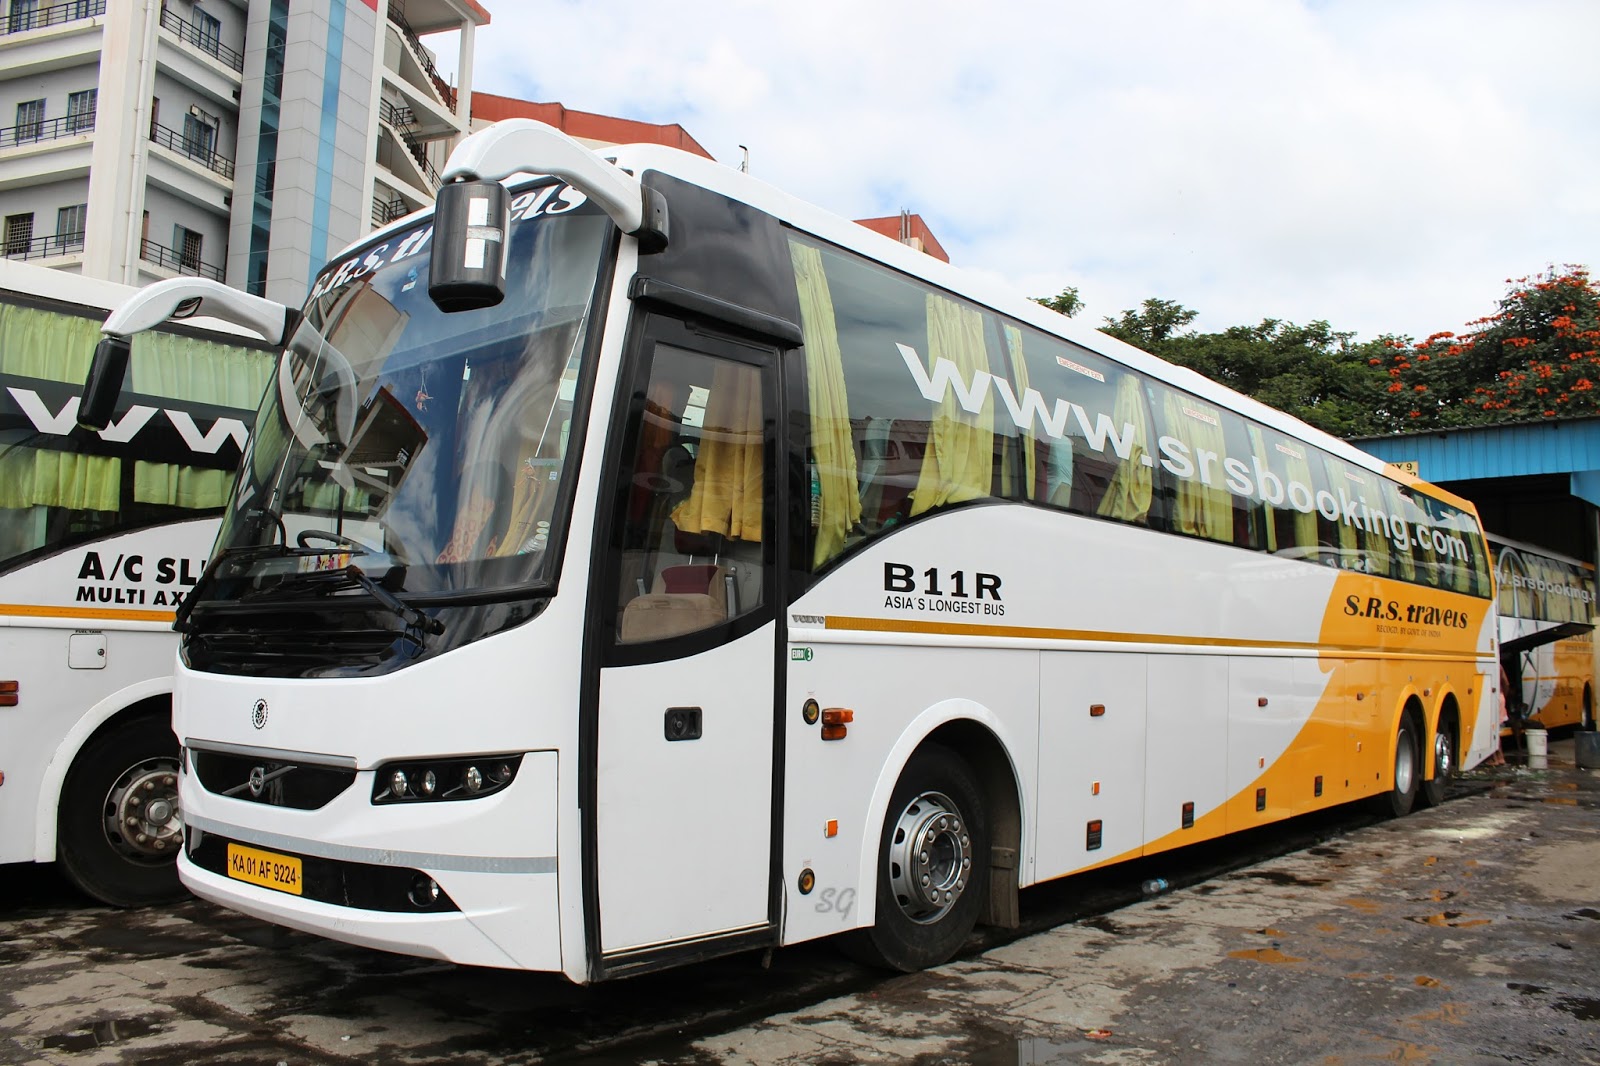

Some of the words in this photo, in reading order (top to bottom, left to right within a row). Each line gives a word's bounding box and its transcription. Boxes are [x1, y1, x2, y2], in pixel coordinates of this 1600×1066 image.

[896, 343, 1468, 562] www.srsbooking.com
[1406, 462, 1412, 471] 9
[78, 551, 143, 582] A/C
[884, 562, 1002, 600] B11R
[76, 586, 145, 605] MULTI
[929, 599, 981, 614] LONGEST
[984, 603, 1005, 616] BUS
[791, 614, 825, 624] VOLVO
[1344, 595, 1402, 621] S.R.S.
[1407, 604, 1468, 629] travels
[792, 649, 804, 659] EURO
[232, 853, 245, 873] KA
[247, 856, 256, 876] 01
[259, 860, 271, 879] AF
[273, 863, 296, 886] 9224
